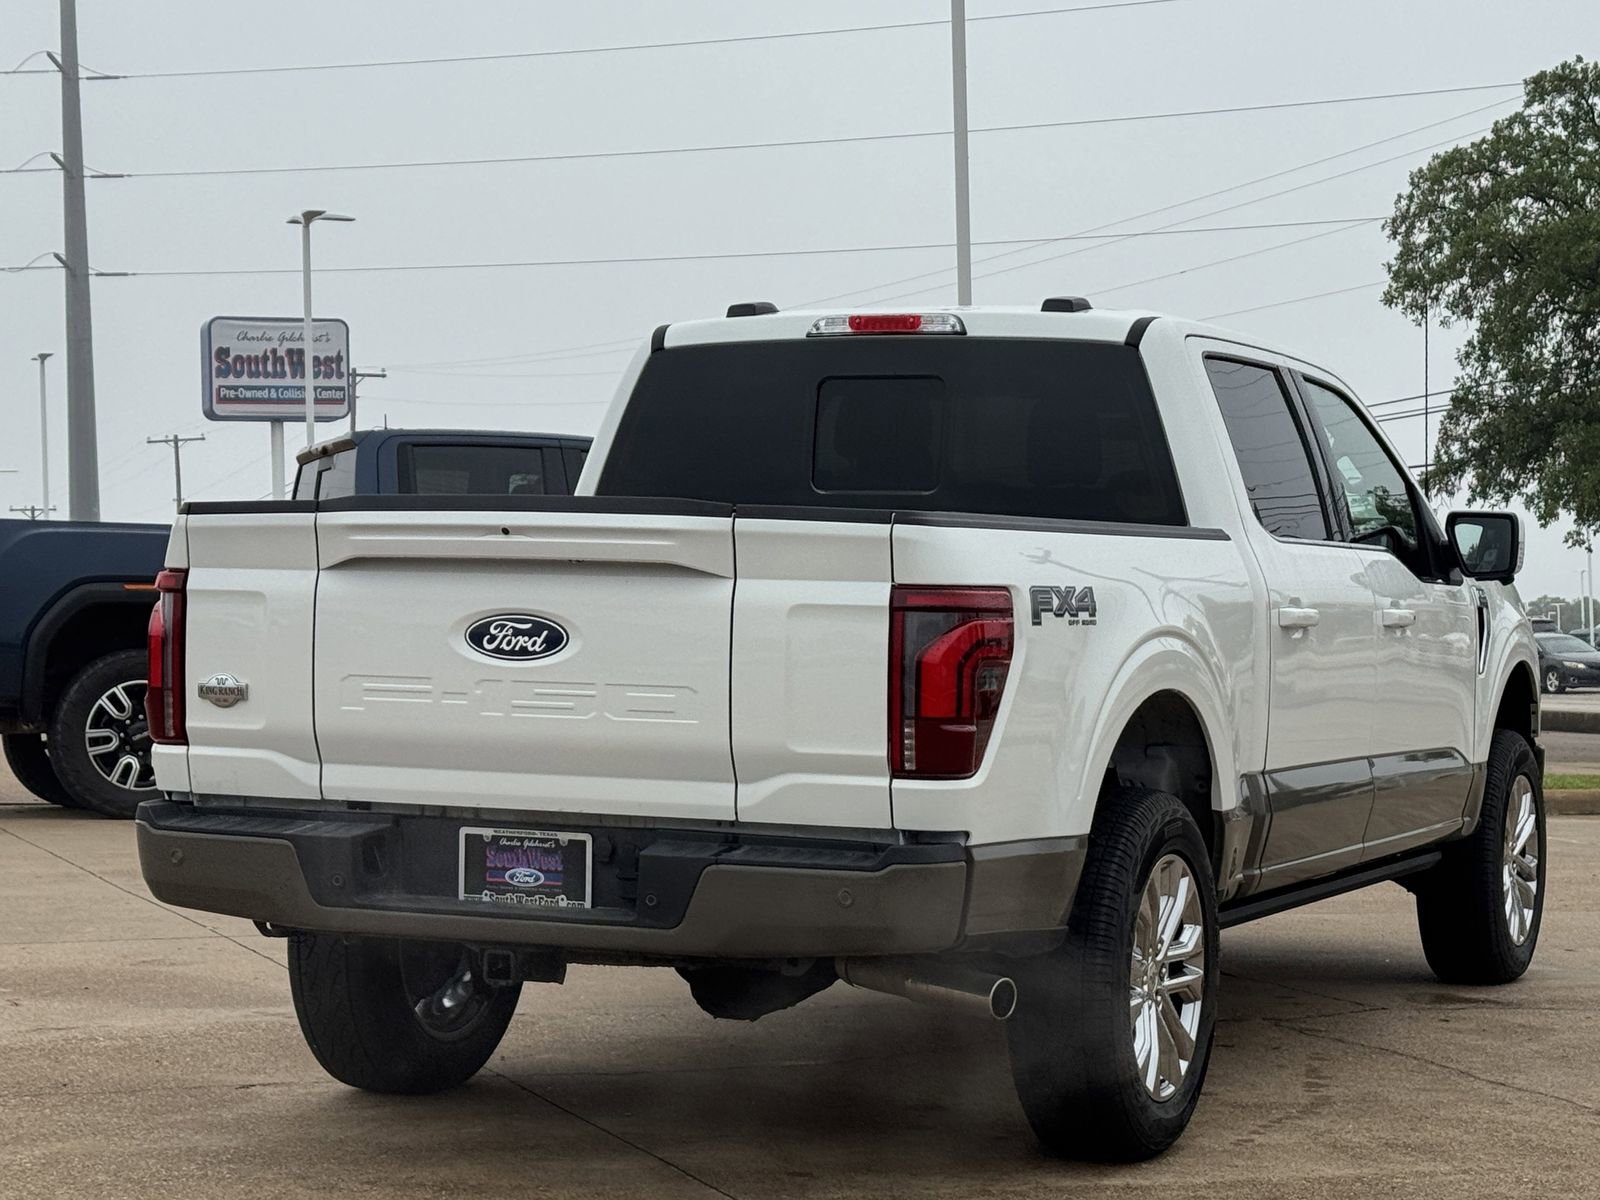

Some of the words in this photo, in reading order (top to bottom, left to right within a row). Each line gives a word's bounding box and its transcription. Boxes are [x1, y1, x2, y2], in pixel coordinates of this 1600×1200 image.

[237, 330, 273, 342] Charlie
[277, 331, 331, 347] Gilchst's
[214, 346, 345, 379] SouthWest
[220, 387, 269, 398] Pre-Owned
[270, 388, 277, 398] &
[278, 387, 316, 398] Collisi
[317, 388, 345, 399] Center
[1029, 586, 1097, 626] FX4
[483, 611, 547, 654] Ford
[340, 673, 700, 723] F-150
[513, 870, 536, 884] Ford
